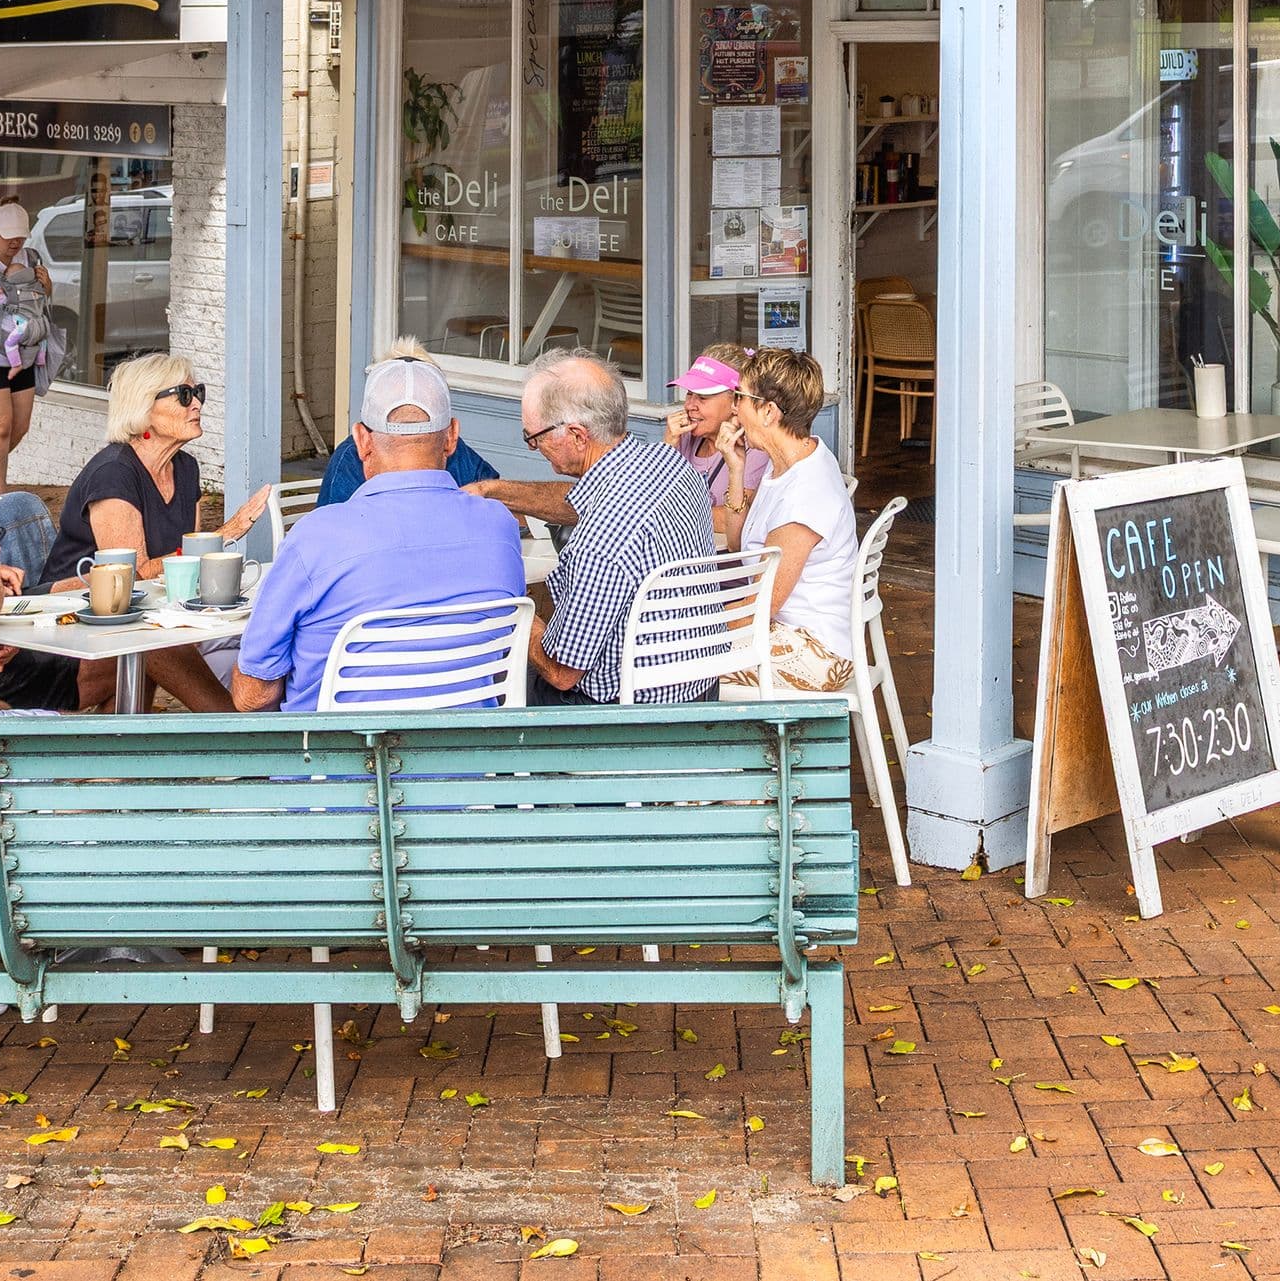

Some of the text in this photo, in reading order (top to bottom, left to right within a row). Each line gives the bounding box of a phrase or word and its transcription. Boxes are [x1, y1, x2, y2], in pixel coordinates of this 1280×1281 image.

[46, 125, 61, 138] 02
[63, 121, 90, 140] 8201
[93, 125, 122, 144] 3289
[418, 171, 498, 208] the Deli
[539, 175, 628, 215] the Deli
[435, 224, 479, 243] CAFE
[1120, 197, 1207, 247] Deli
[1106, 517, 1177, 579] CAFE
[1161, 555, 1225, 599] OPEN
[1141, 699, 1153, 715] our
[1180, 683, 1200, 699] closes
